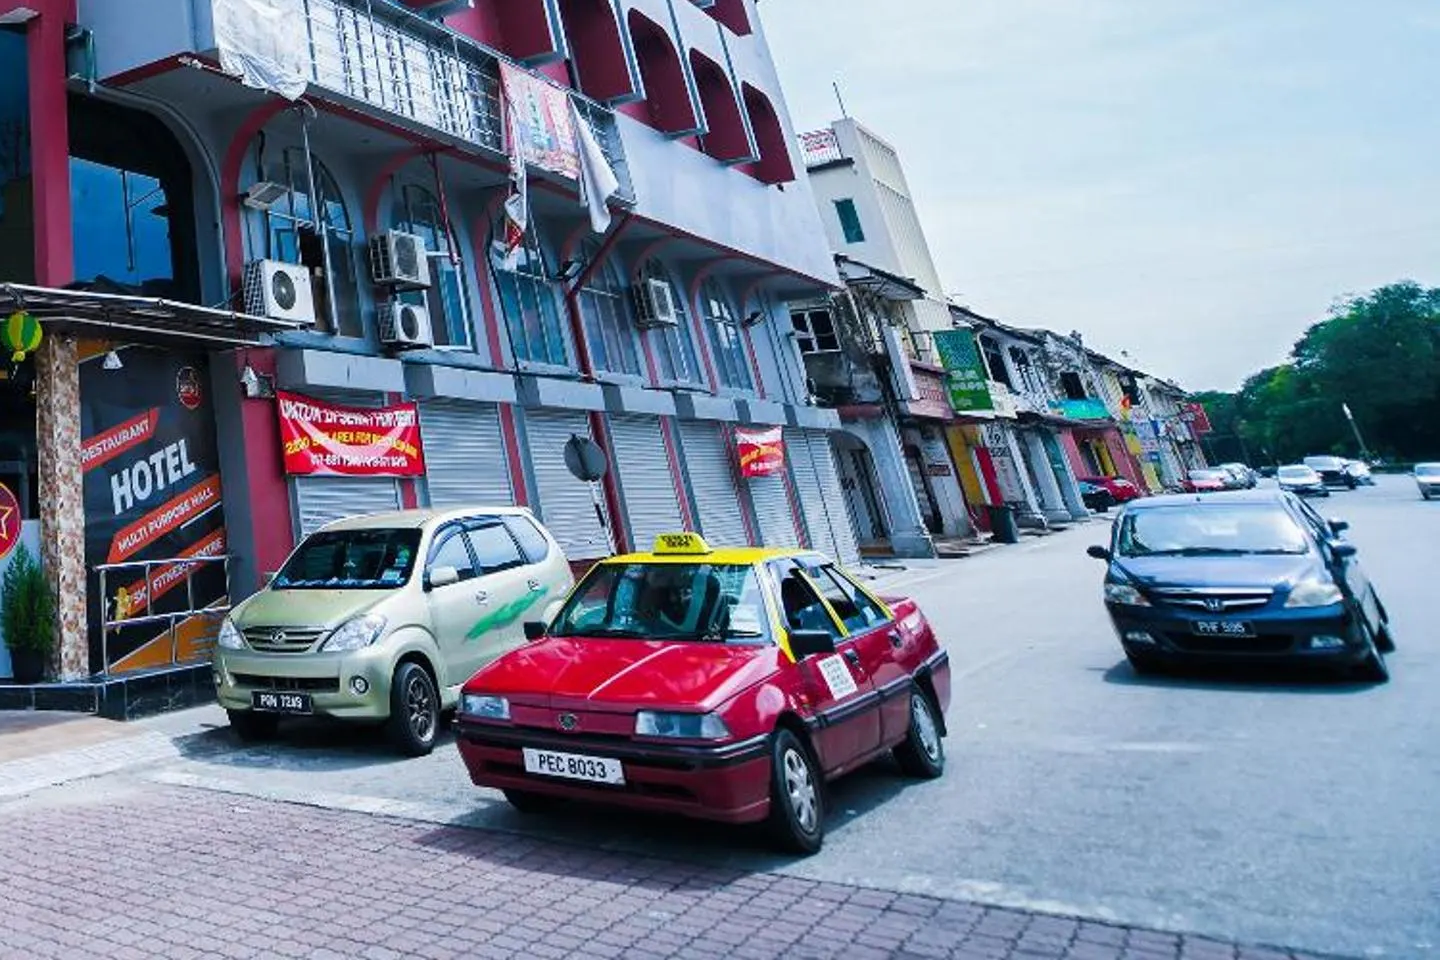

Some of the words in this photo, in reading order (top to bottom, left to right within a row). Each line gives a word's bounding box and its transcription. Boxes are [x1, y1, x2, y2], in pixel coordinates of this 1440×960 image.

[81, 418, 149, 463] RESTAURANT
[111, 438, 196, 515] HOTEL
[118, 526, 149, 553] MULTI
[148, 500, 192, 535] PURPOSE
[191, 487, 214, 509] HALL
[538, 754, 566, 772] PEC
[568, 757, 607, 778] 8033
